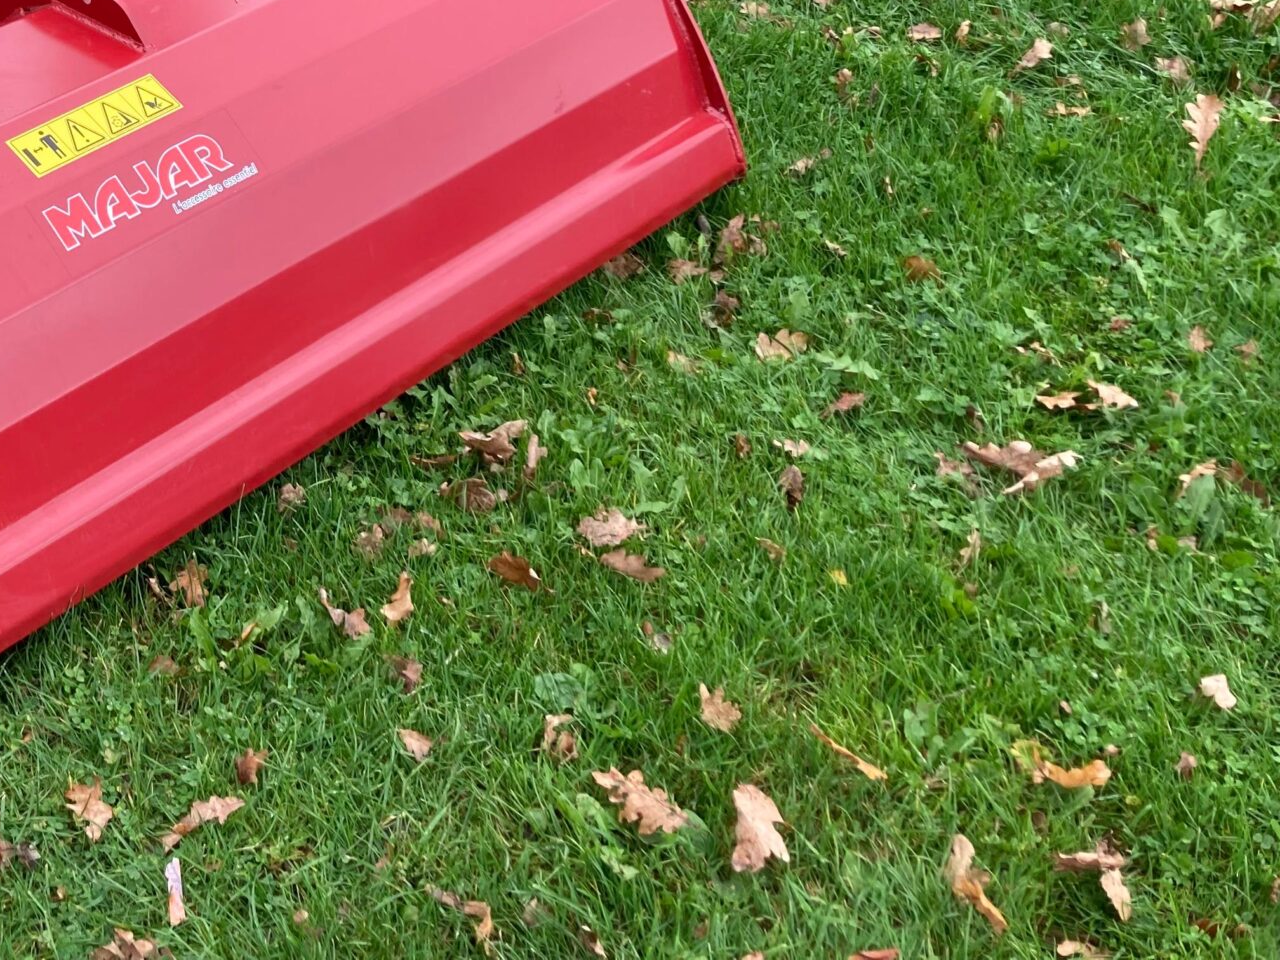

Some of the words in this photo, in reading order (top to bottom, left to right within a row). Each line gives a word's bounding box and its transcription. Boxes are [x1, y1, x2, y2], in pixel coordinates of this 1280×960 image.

[42, 134, 234, 251] MAJAR
[172, 184, 224, 215] L'accessoire
[223, 162, 259, 189] essentiel
